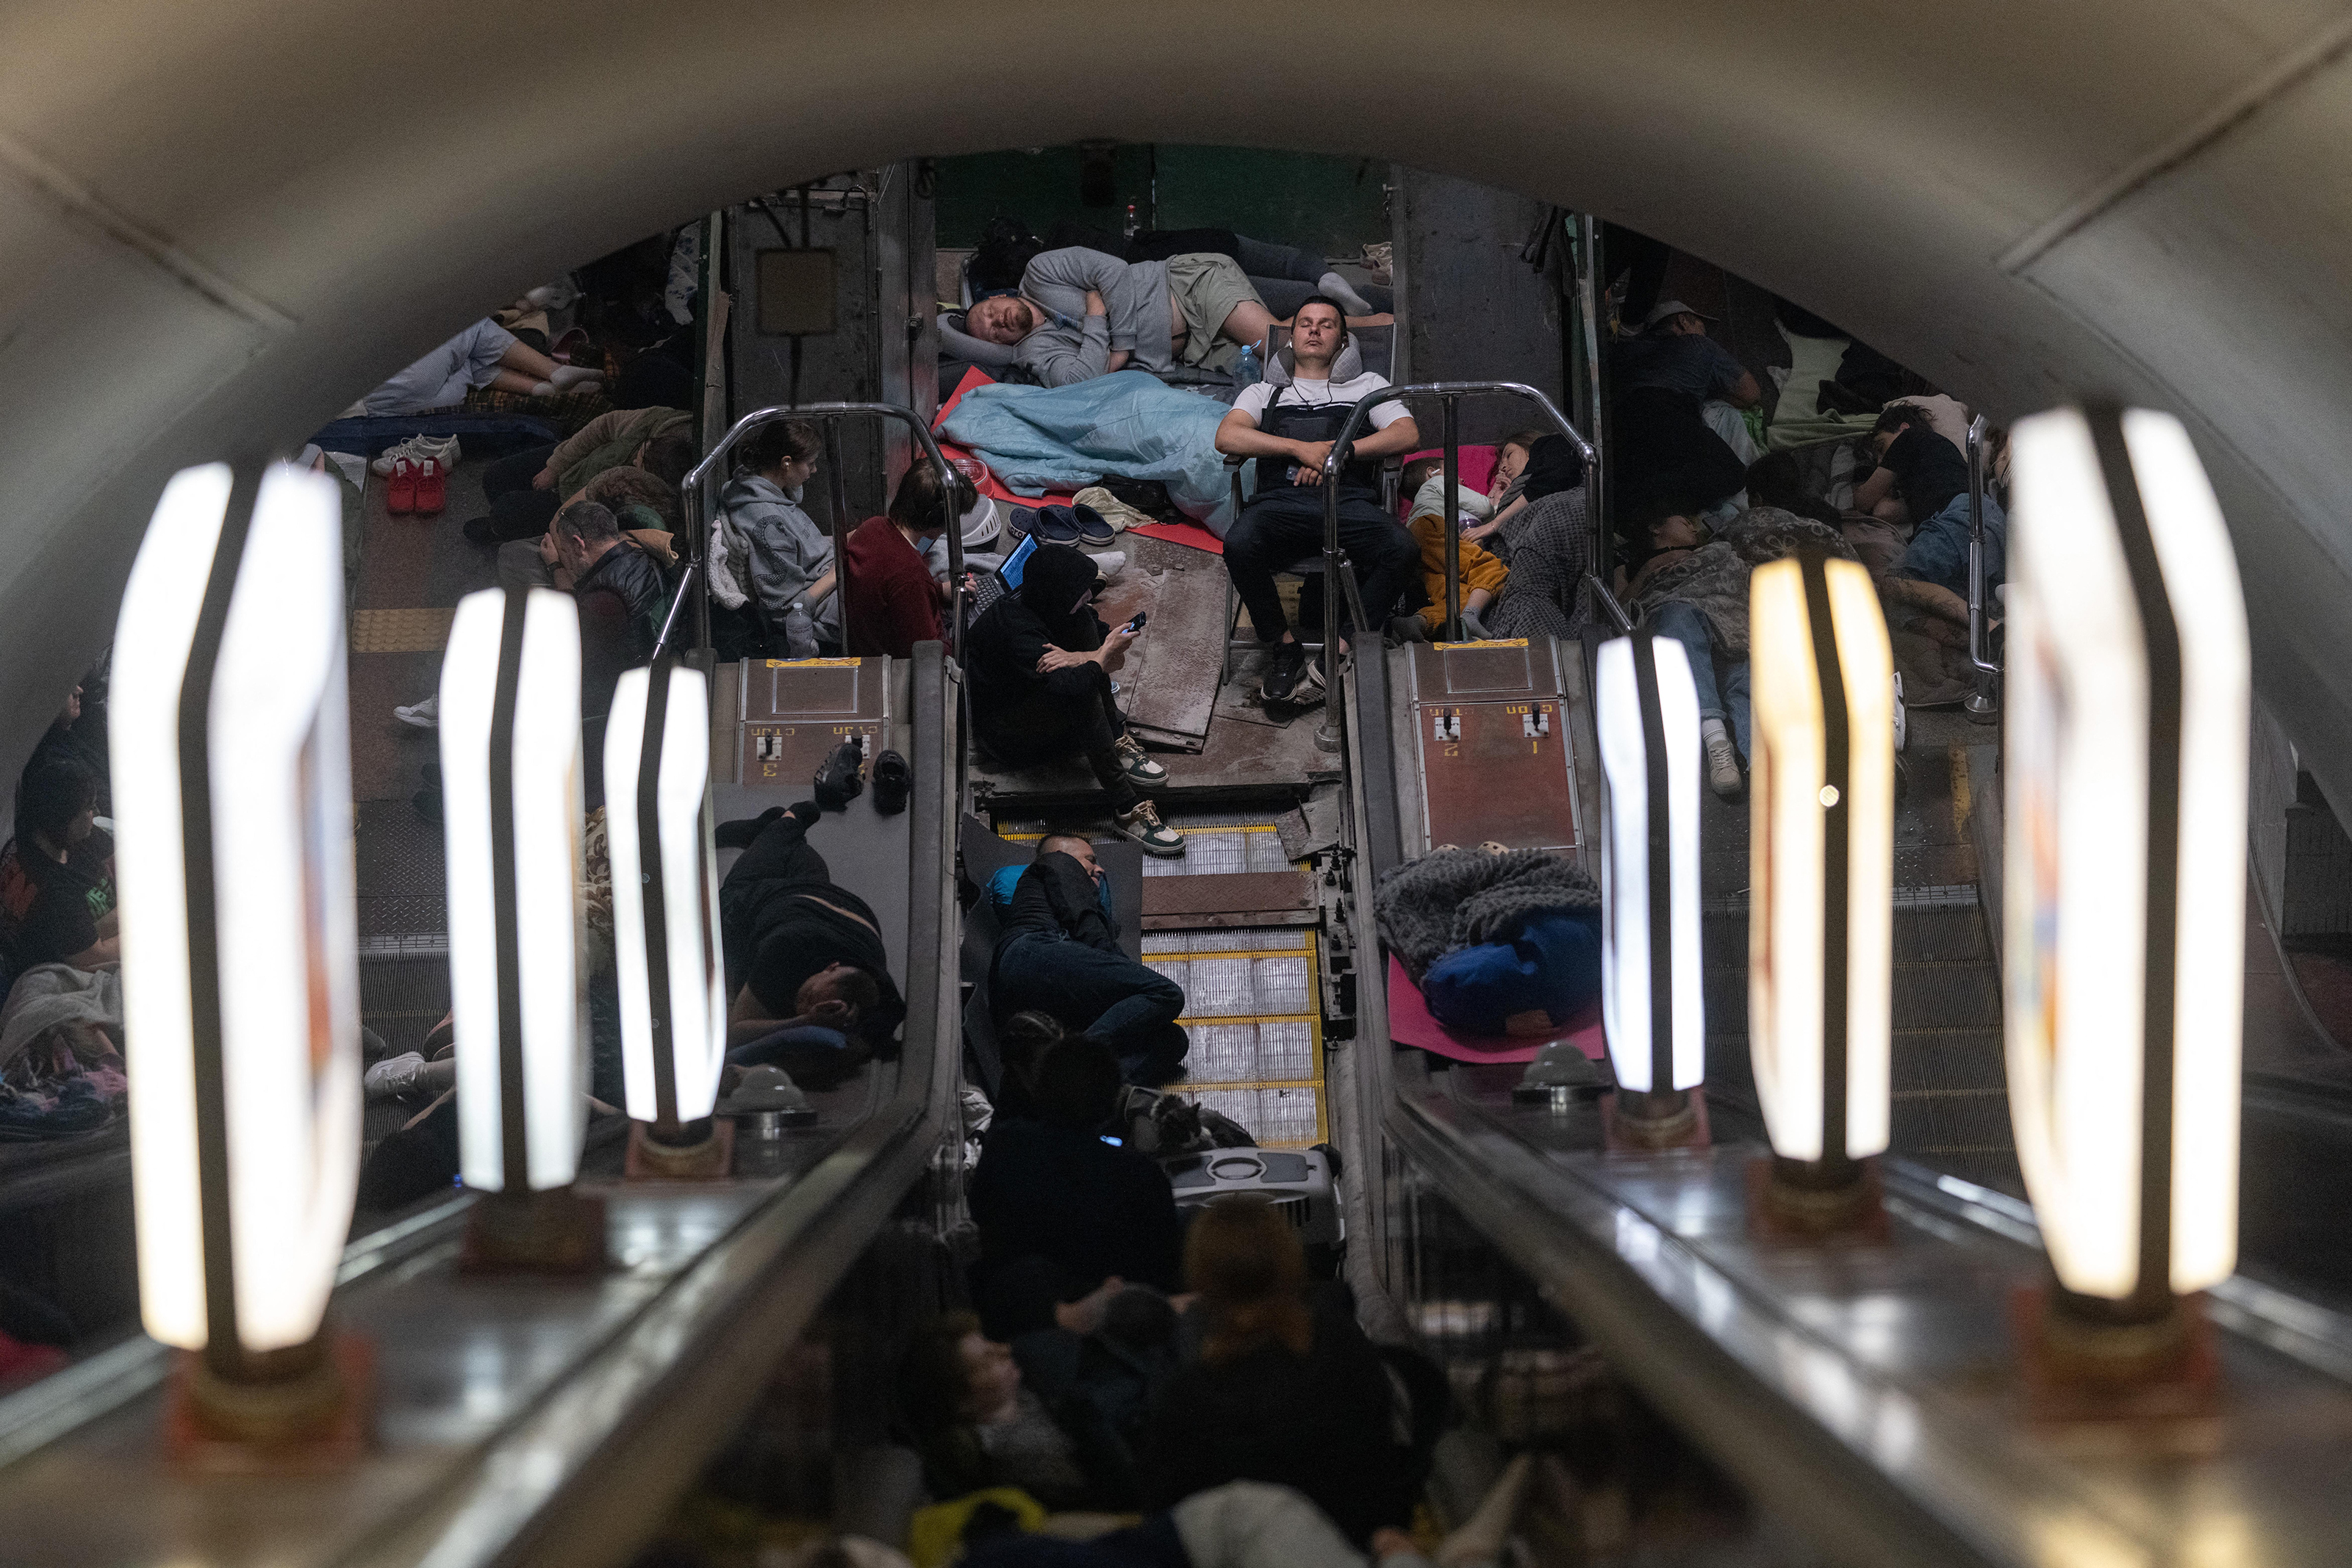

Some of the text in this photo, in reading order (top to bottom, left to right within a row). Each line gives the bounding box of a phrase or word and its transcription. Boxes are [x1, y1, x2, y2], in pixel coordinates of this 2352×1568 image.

[1506, 705, 1552, 714] СОП
[1444, 743, 1458, 756] 2
[764, 763, 777, 777] 3
